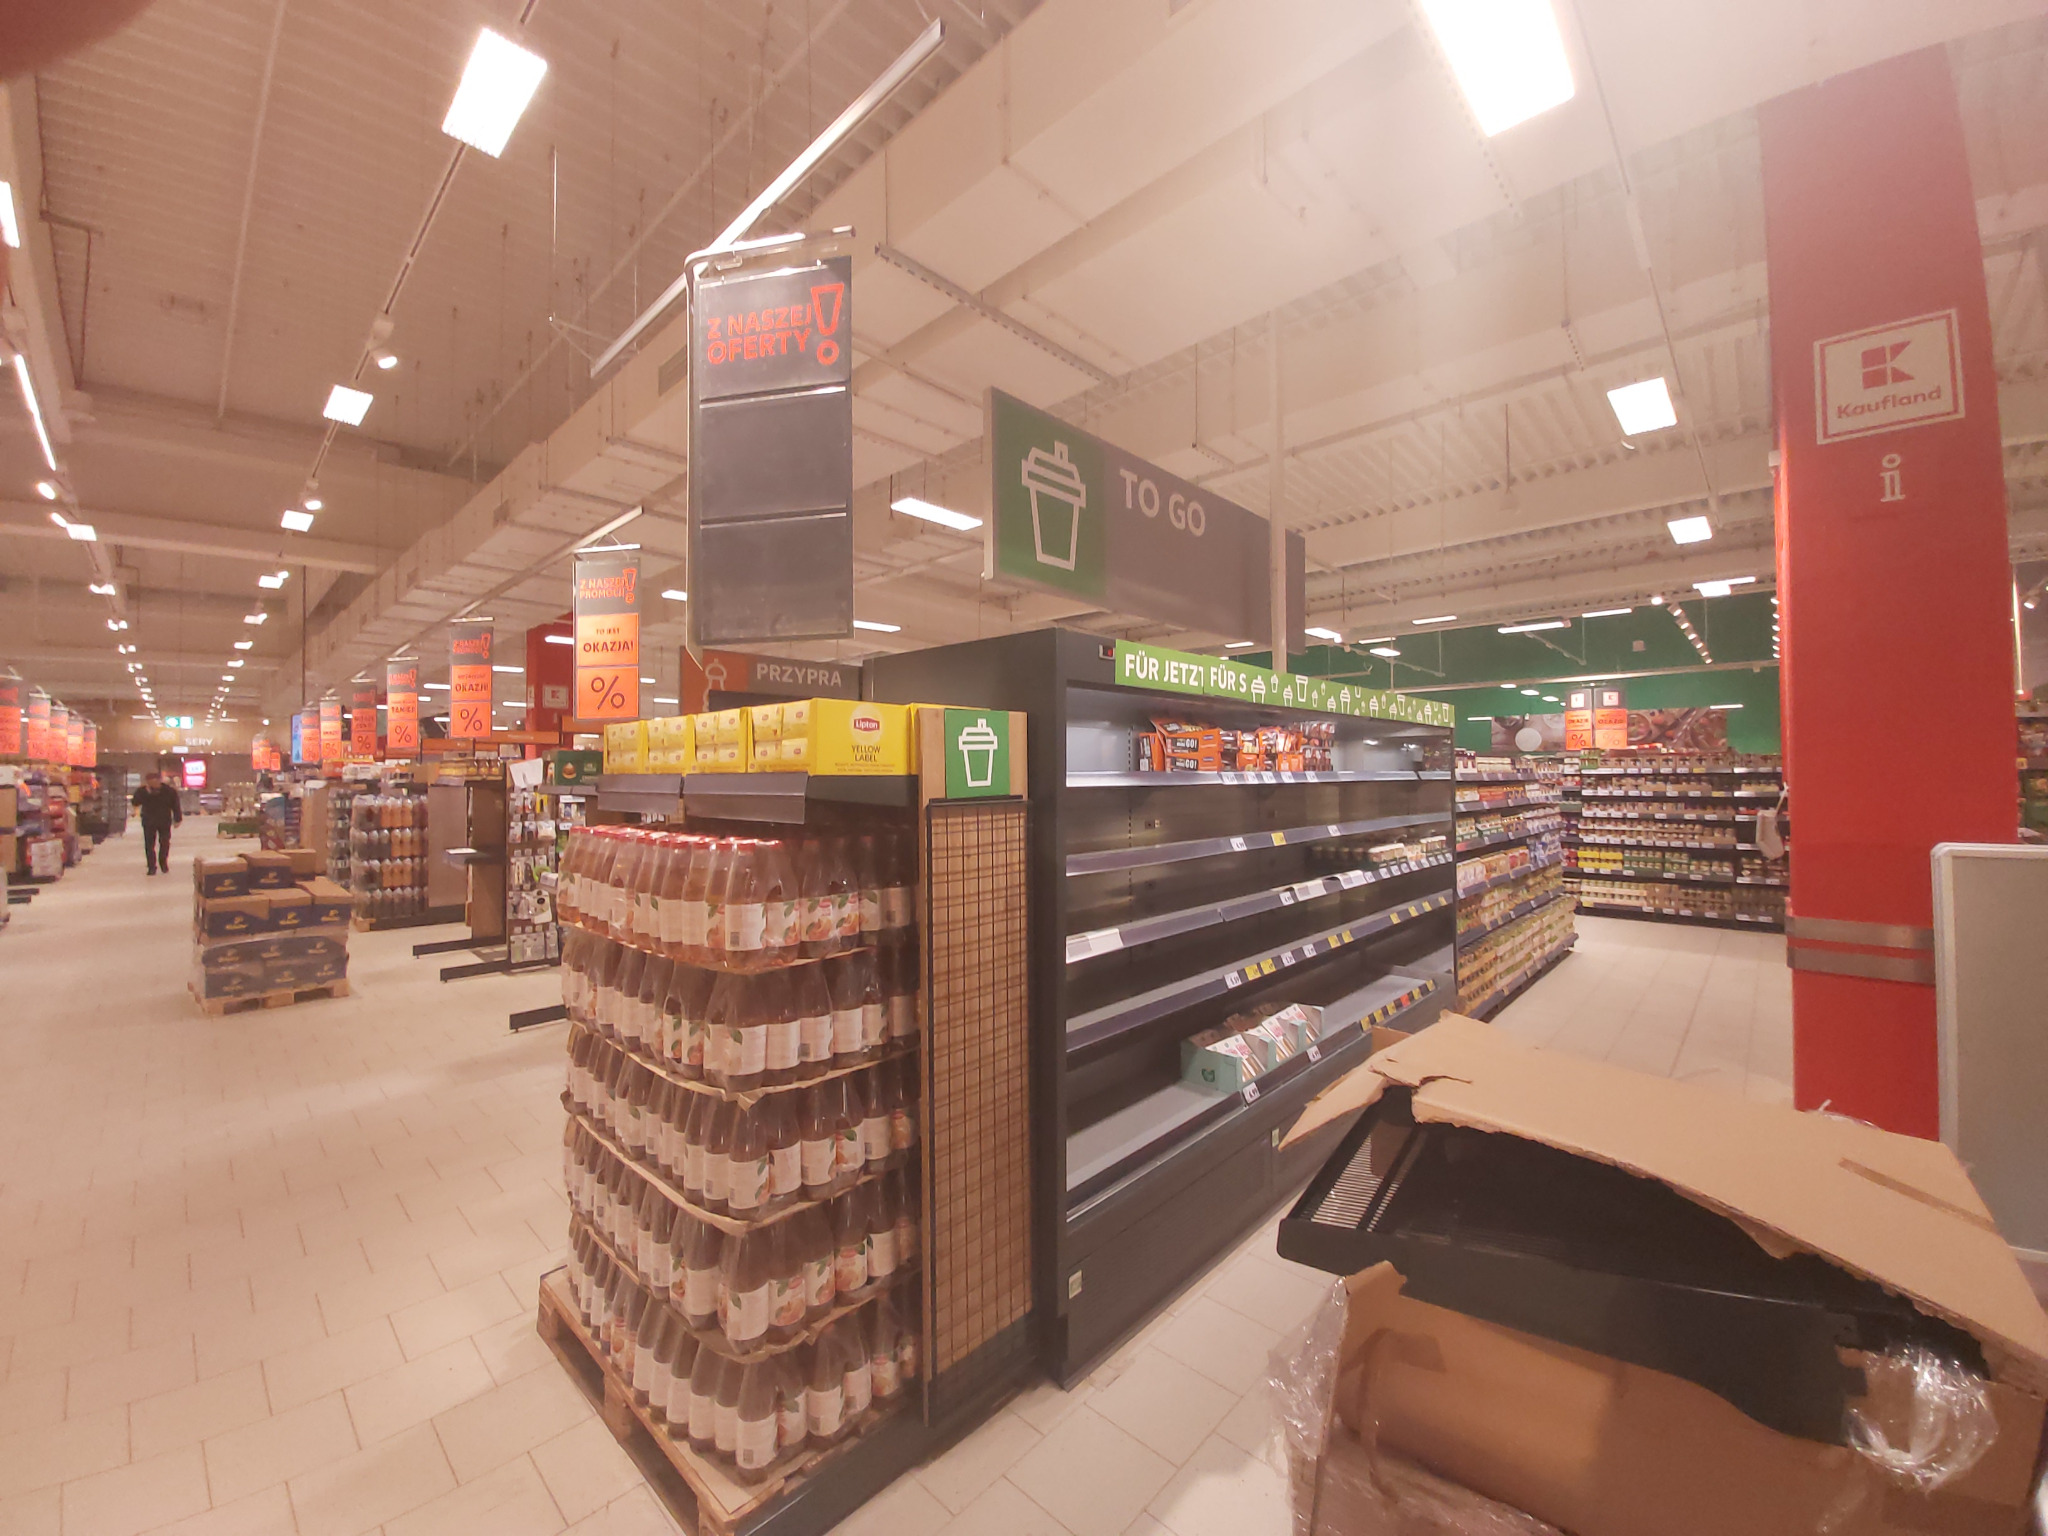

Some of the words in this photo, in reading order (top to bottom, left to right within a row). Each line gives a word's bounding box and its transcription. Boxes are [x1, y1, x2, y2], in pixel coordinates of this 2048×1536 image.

[706, 317, 723, 340] Z
[727, 303, 813, 336] NASZEJ
[706, 327, 811, 365] OFERTY
[1836, 385, 1942, 419] Kaufland
[1119, 468, 1160, 518] TO
[1168, 494, 1206, 537] GO
[582, 640, 634, 653] OKAZJA!
[756, 663, 842, 688] PRZYPRA
[1125, 649, 1159, 681] FÜR
[1210, 664, 1236, 691] FÜR
[1238, 672, 1247, 693] S
[855, 719, 879, 730] Lipton
[851, 744, 881, 754] YELLOW
[854, 753, 877, 762] LABEL
